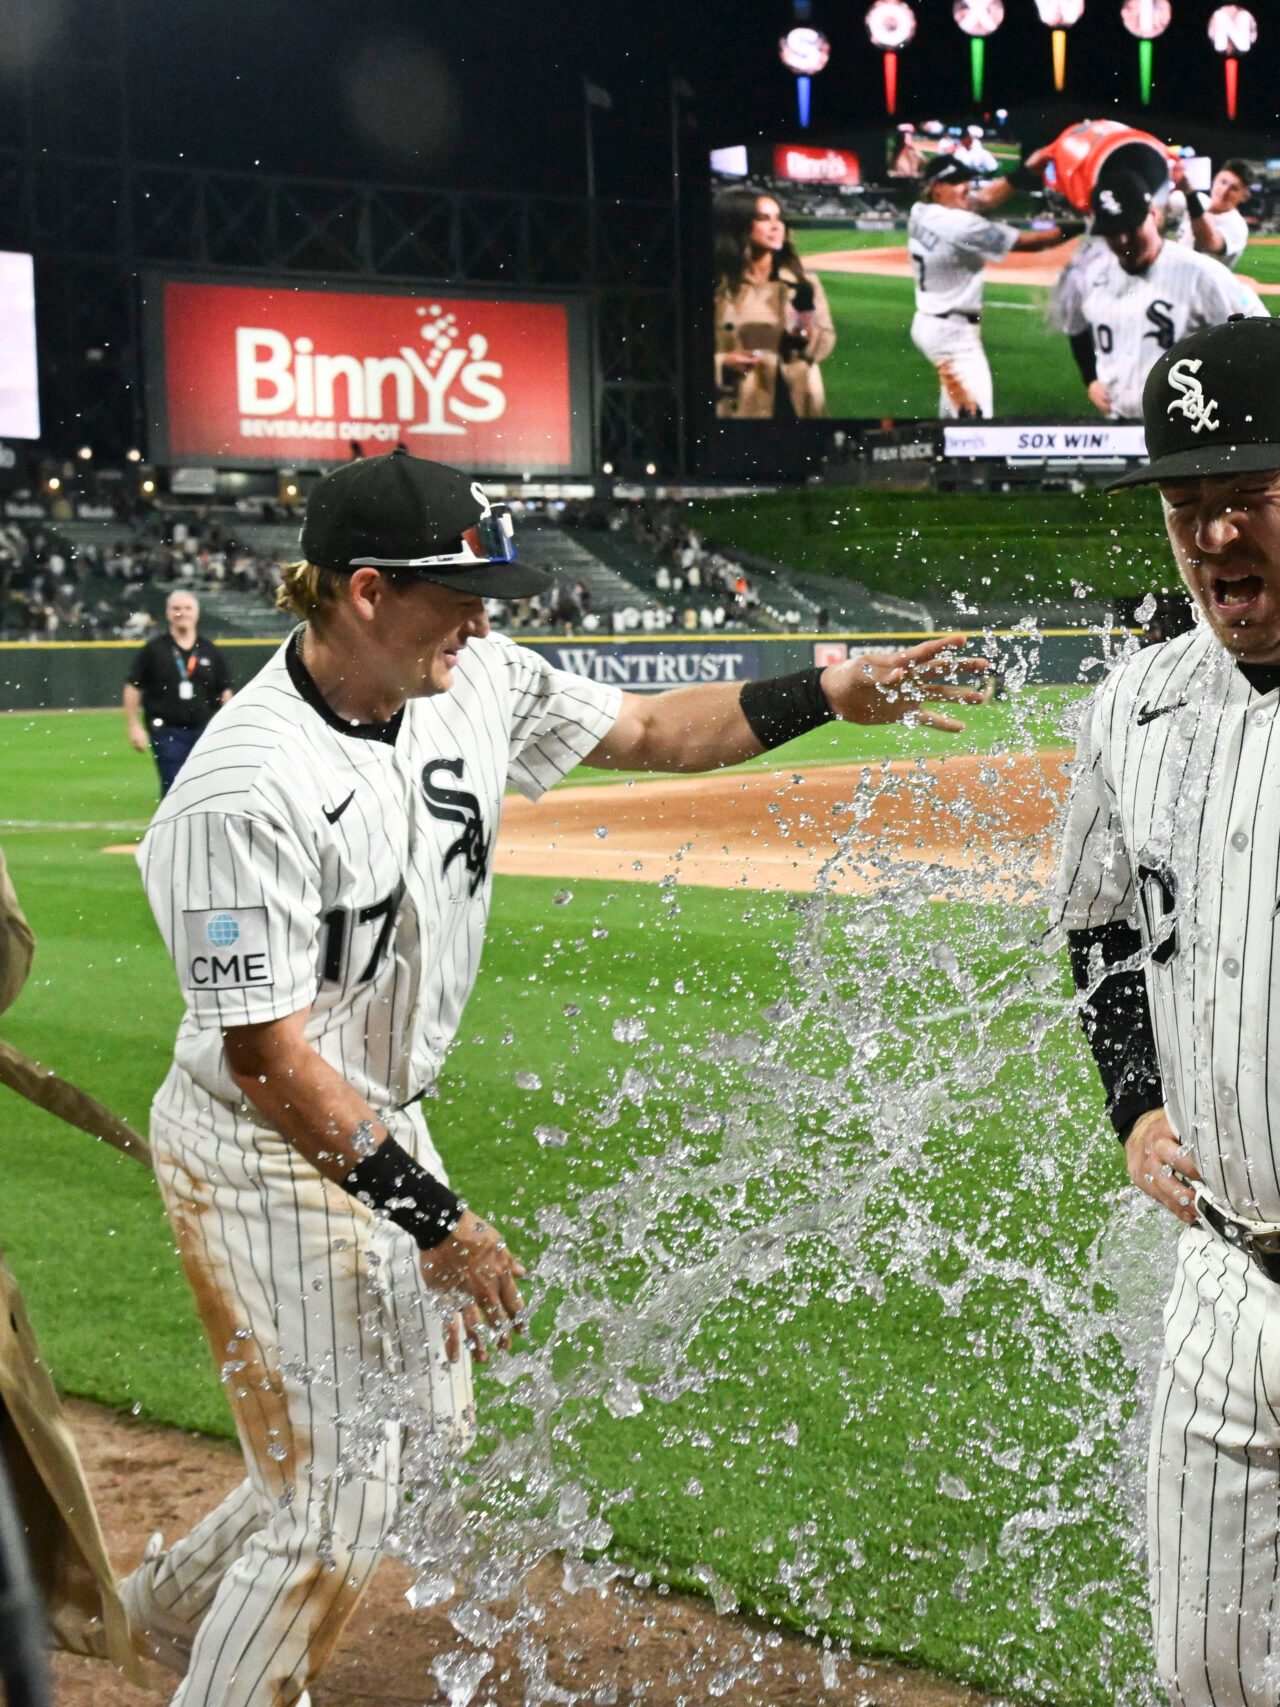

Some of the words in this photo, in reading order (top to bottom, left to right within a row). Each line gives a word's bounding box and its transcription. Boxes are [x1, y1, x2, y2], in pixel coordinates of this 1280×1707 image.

[240, 418, 337, 440] BEVERAGE
[338, 421, 401, 441] DEPOT
[1018, 433, 1056, 448] SOX
[1064, 432, 1109, 448] WIN!
[556, 649, 744, 683] WINTRUST
[320, 894, 401, 986] 17
[190, 952, 268, 985] CME
